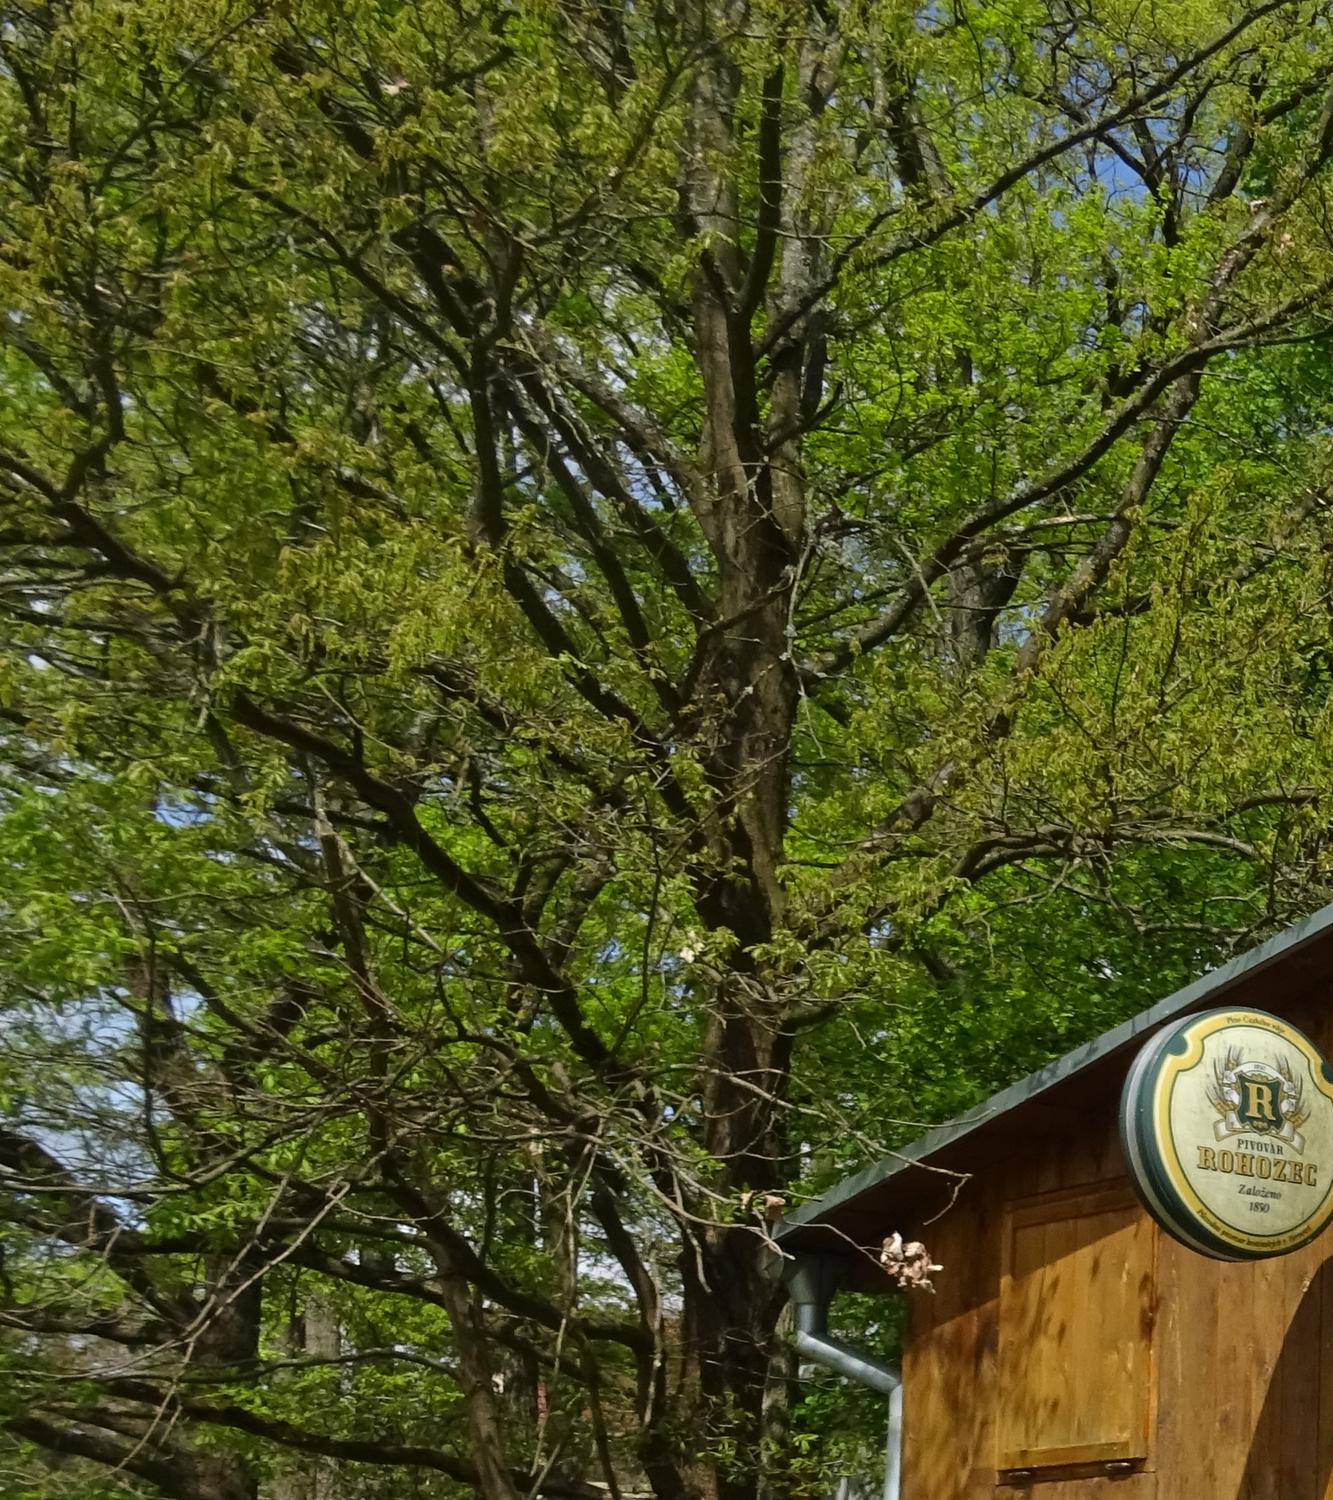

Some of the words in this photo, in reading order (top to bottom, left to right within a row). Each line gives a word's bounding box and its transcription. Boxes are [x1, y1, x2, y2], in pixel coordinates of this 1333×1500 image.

[1244, 1082, 1276, 1121] R
[1237, 1138, 1284, 1155] PIVOVAR
[1197, 1145, 1318, 1187] ROHOZEC
[1238, 1184, 1282, 1200] Založeno
[1249, 1201, 1270, 1213] 1850
